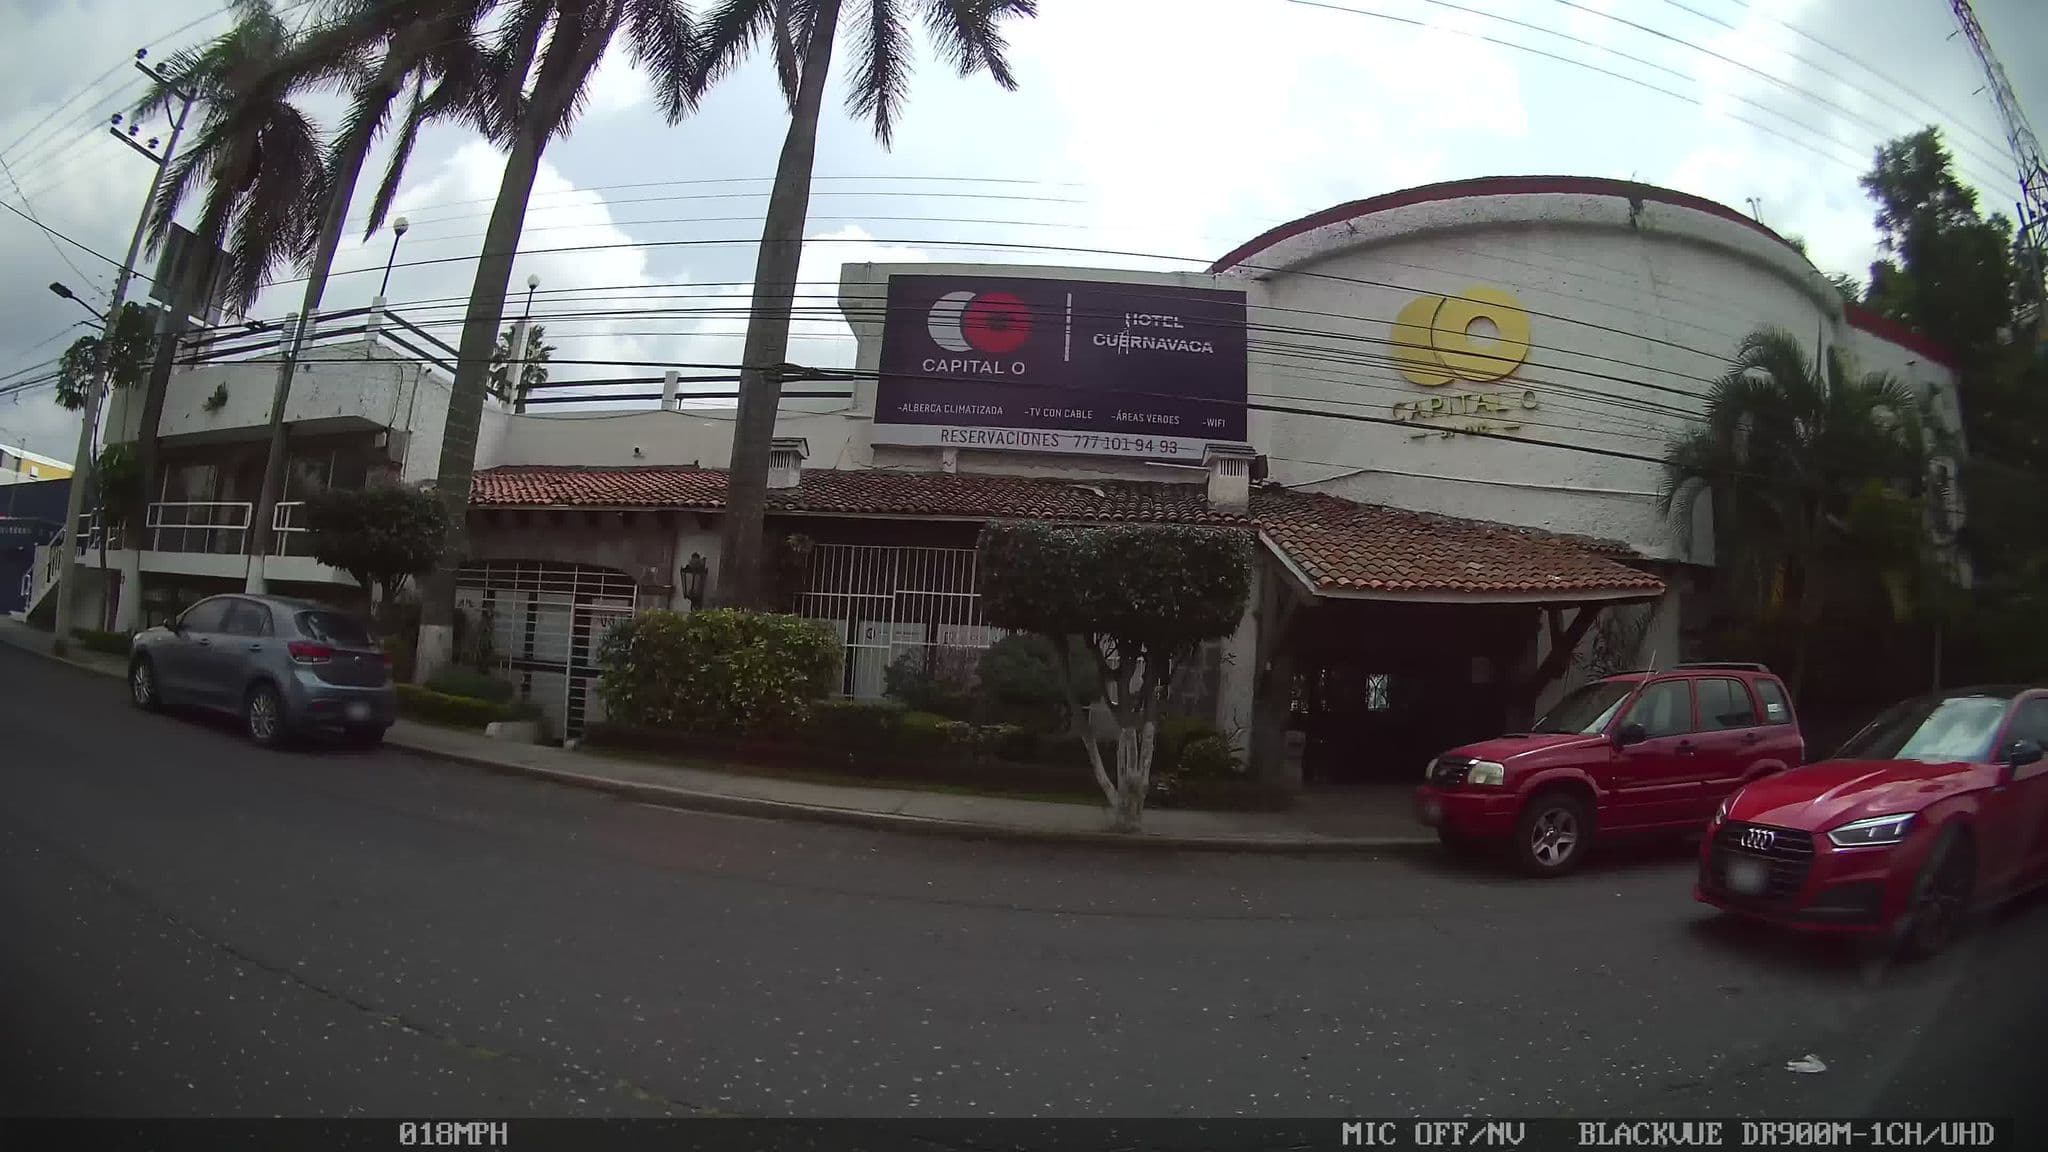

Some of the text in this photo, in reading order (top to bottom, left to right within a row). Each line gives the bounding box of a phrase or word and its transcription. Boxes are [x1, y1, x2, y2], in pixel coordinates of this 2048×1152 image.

[1125, 313, 1184, 329] HOTEL
[1093, 333, 1214, 353] CUERNAVACA
[922, 358, 1026, 376] CAPITAL O
[897, 403, 1004, 416] -ALBERCA CLIMATIZADA
[1043, 408, 1062, 418] CON
[1064, 409, 1093, 420] CABLE
[1147, 413, 1180, 425] VERDES
[941, 429, 1178, 454] RESERVACIONES 777 101 94 93
